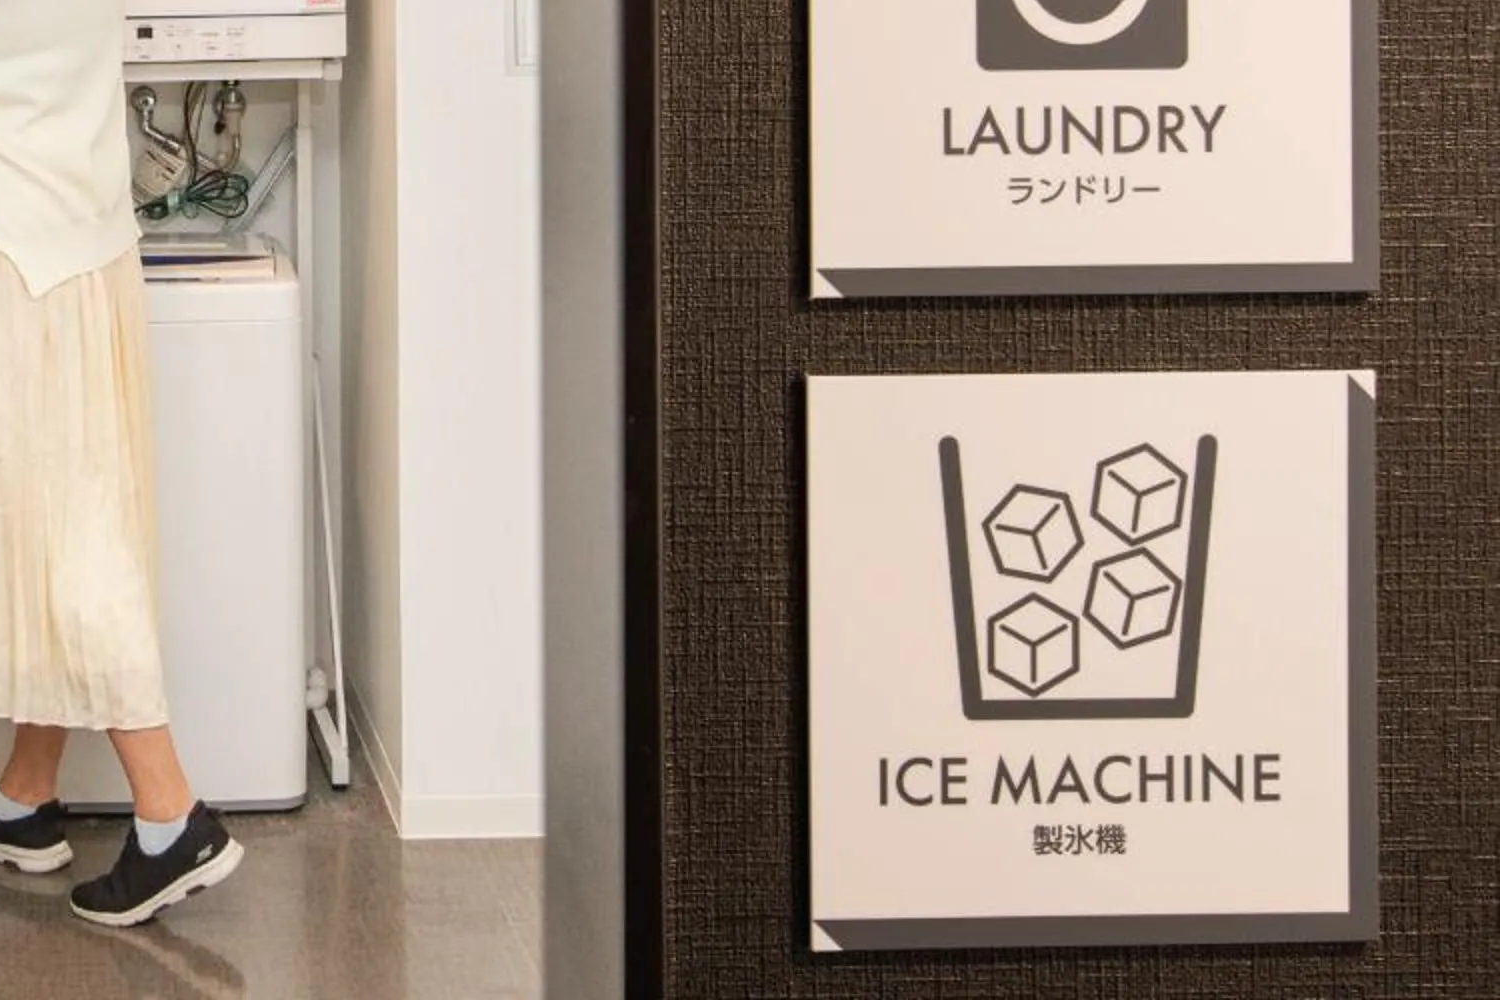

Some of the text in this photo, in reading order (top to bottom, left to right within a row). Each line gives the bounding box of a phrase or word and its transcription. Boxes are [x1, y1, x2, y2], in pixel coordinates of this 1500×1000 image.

[942, 104, 1227, 156] LAUNDRY
[1008, 175, 1161, 206] ランドリー
[878, 753, 1281, 807] ICE MACHINE
[1032, 824, 1127, 856] 製氷機
